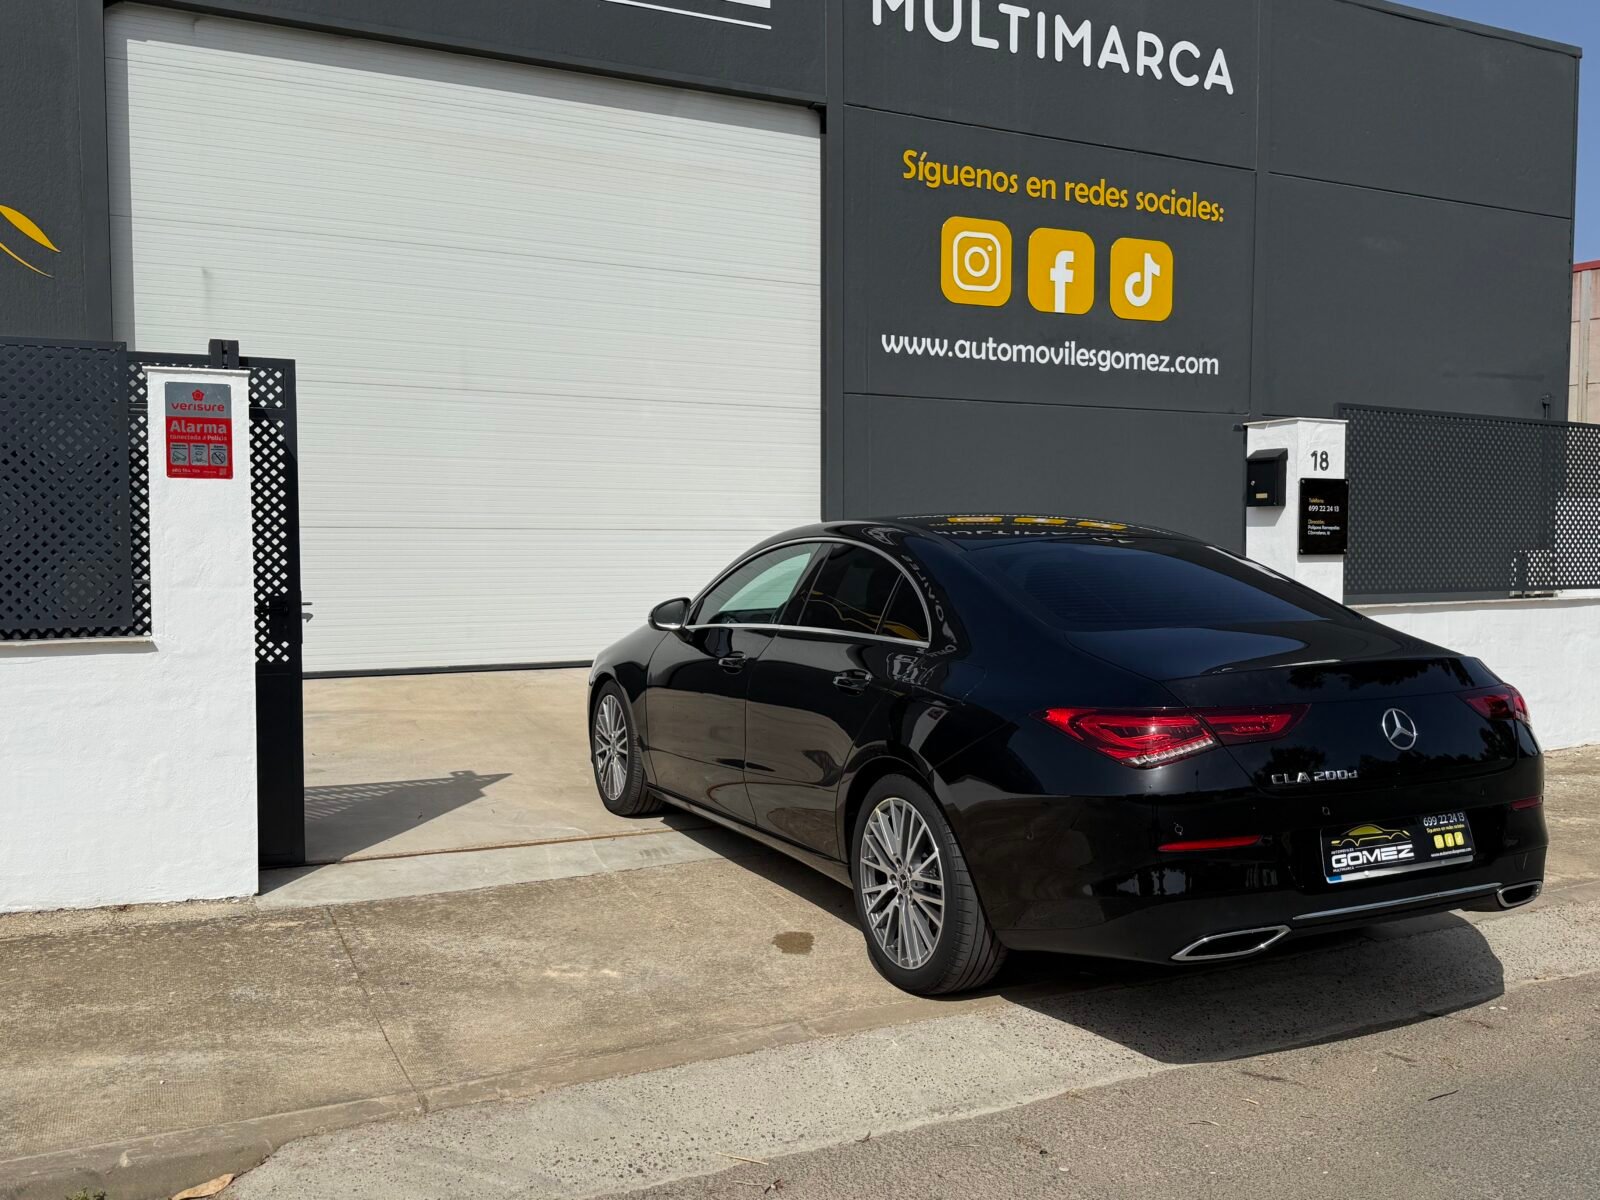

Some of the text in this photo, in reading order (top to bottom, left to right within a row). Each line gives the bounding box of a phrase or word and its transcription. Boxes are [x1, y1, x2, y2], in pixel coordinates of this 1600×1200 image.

[873, 0, 1234, 95] MULTIMARCA
[902, 149, 1224, 221] Síguenos en redes sociales:
[881, 333, 1219, 375] www.automovilesgomez.com
[171, 402, 225, 412] verisure
[170, 420, 227, 434] Alarma
[1311, 450, 1329, 471] 18
[1271, 769, 1358, 784] CLA 200d
[1423, 812, 1465, 826] 699 22 24 13
[1331, 844, 1415, 868] GOMEZ
